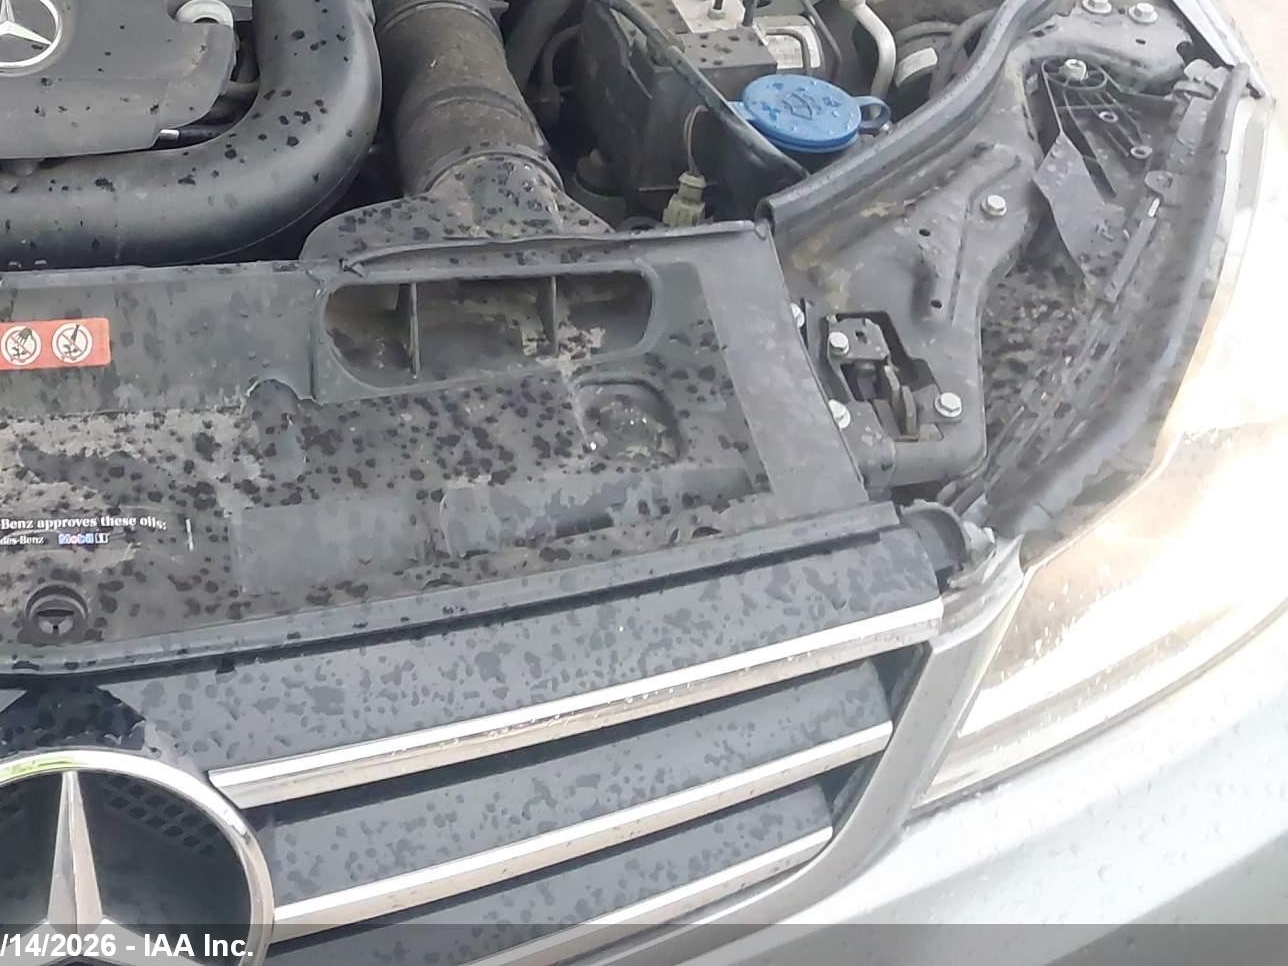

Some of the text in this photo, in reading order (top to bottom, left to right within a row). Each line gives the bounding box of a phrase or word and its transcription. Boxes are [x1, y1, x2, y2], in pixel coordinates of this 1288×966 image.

[36, 517, 97, 530] approves
[100, 515, 137, 527] these
[139, 516, 167, 530] oils:
[58, 533, 94, 545] Mobil
